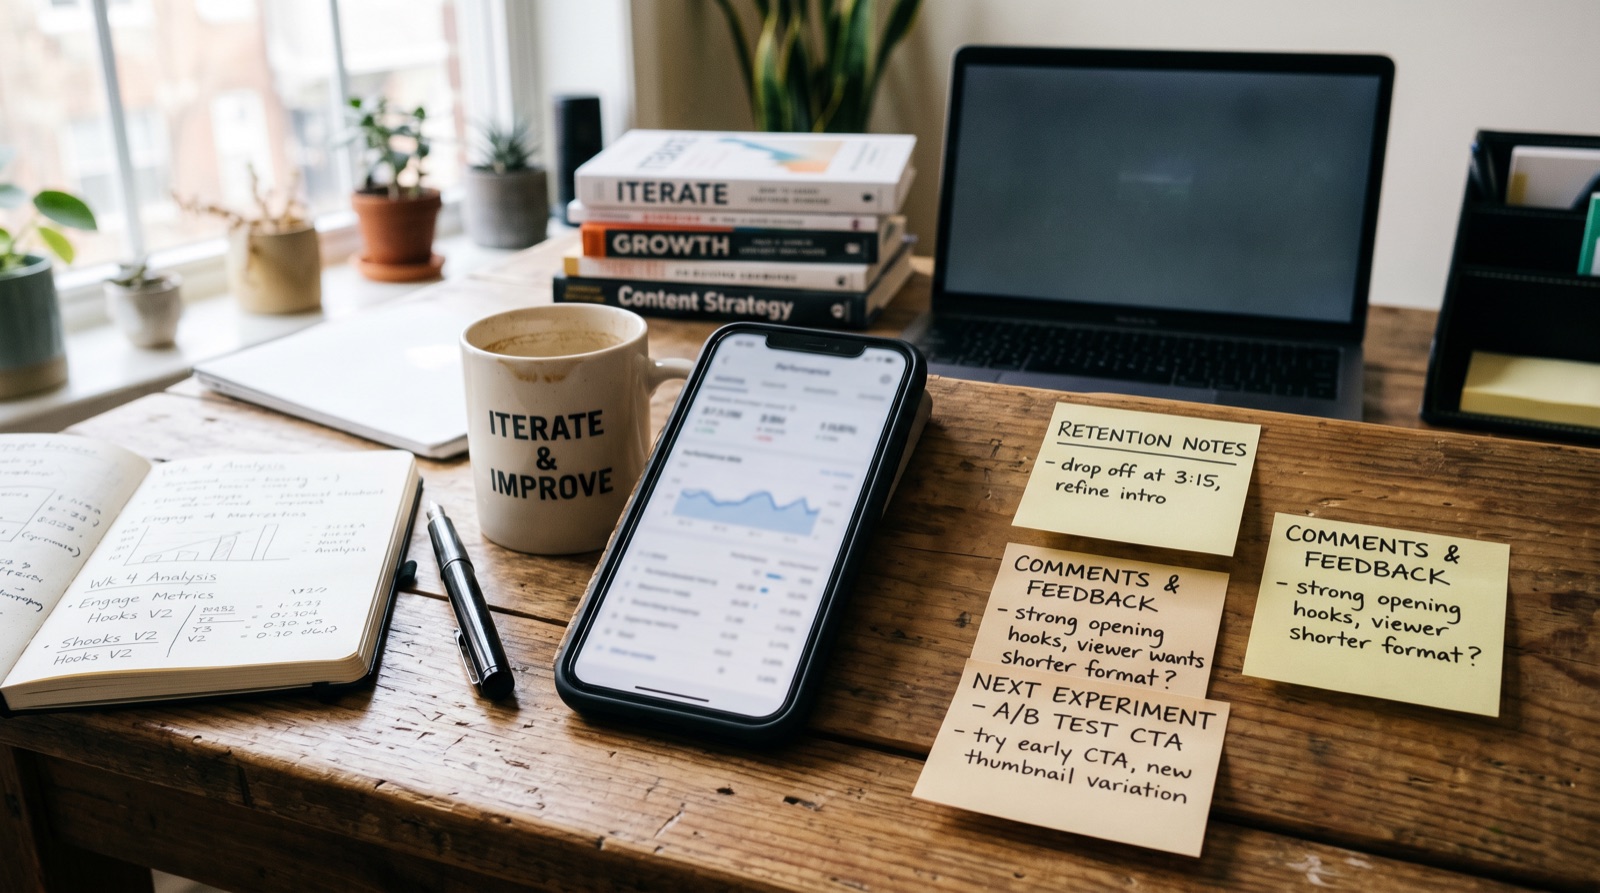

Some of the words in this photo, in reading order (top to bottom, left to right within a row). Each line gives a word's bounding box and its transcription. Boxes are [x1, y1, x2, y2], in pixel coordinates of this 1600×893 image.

[617, 181, 728, 205] ITERATE
[612, 233, 730, 256] GROWTH
[618, 285, 699, 311] Content
[703, 291, 794, 320] Strategy
[489, 409, 604, 441] ITERATE
[1057, 420, 1172, 448] RETENTION
[1182, 437, 1247, 457] NOTES
[536, 446, 558, 471] &
[1061, 457, 1102, 479] drop
[1108, 462, 1138, 478] off
[1143, 468, 1166, 482] at
[1174, 470, 1221, 492] 3:15,
[490, 467, 614, 501] IMPROVE
[1055, 480, 1109, 498] refine
[1120, 487, 1166, 505] intro
[1286, 524, 1429, 558] COMMENTS
[1443, 544, 1461, 565] &
[90, 576, 117, 590] Wk
[126, 573, 138, 584] 4
[146, 571, 217, 586] Analysis
[1014, 555, 1150, 588] COMMENTS
[1163, 574, 1181, 594] &
[1305, 550, 1451, 586] FEEDBACK
[78, 595, 140, 609] Engage
[152, 591, 214, 601] Metrics
[1026, 579, 1158, 613] FEEDBACK
[1296, 580, 1364, 611] strong
[1377, 595, 1462, 624] opening
[87, 611, 138, 624] Hooks
[149, 608, 173, 619] V2
[1015, 606, 1078, 635] strong
[1088, 619, 1164, 648] opening
[1293, 600, 1360, 630] hooks,
[1371, 615, 1449, 636] viewer
[60, 633, 121, 649] Shooks
[134, 631, 158, 641] V2
[1008, 625, 1067, 653] hooks,
[1077, 638, 1142, 659] viewer
[1150, 650, 1205, 669] wants
[1289, 626, 1372, 649] shorter
[53, 651, 99, 666] Hooks
[109, 648, 132, 659] V2
[1001, 649, 1077, 672] shorter
[972, 672, 1042, 699] NEXT
[1052, 686, 1217, 730] EXPERIMENT
[992, 702, 1040, 725] A/B
[1053, 713, 1119, 738] TEST
[1130, 728, 1183, 751] CTA
[973, 727, 1007, 754] try
[1018, 741, 1072, 766] early
[1084, 748, 1136, 774] CTA,
[1147, 762, 1192, 779] new
[964, 749, 1075, 784] thumbnail
[1087, 776, 1188, 804] variation
